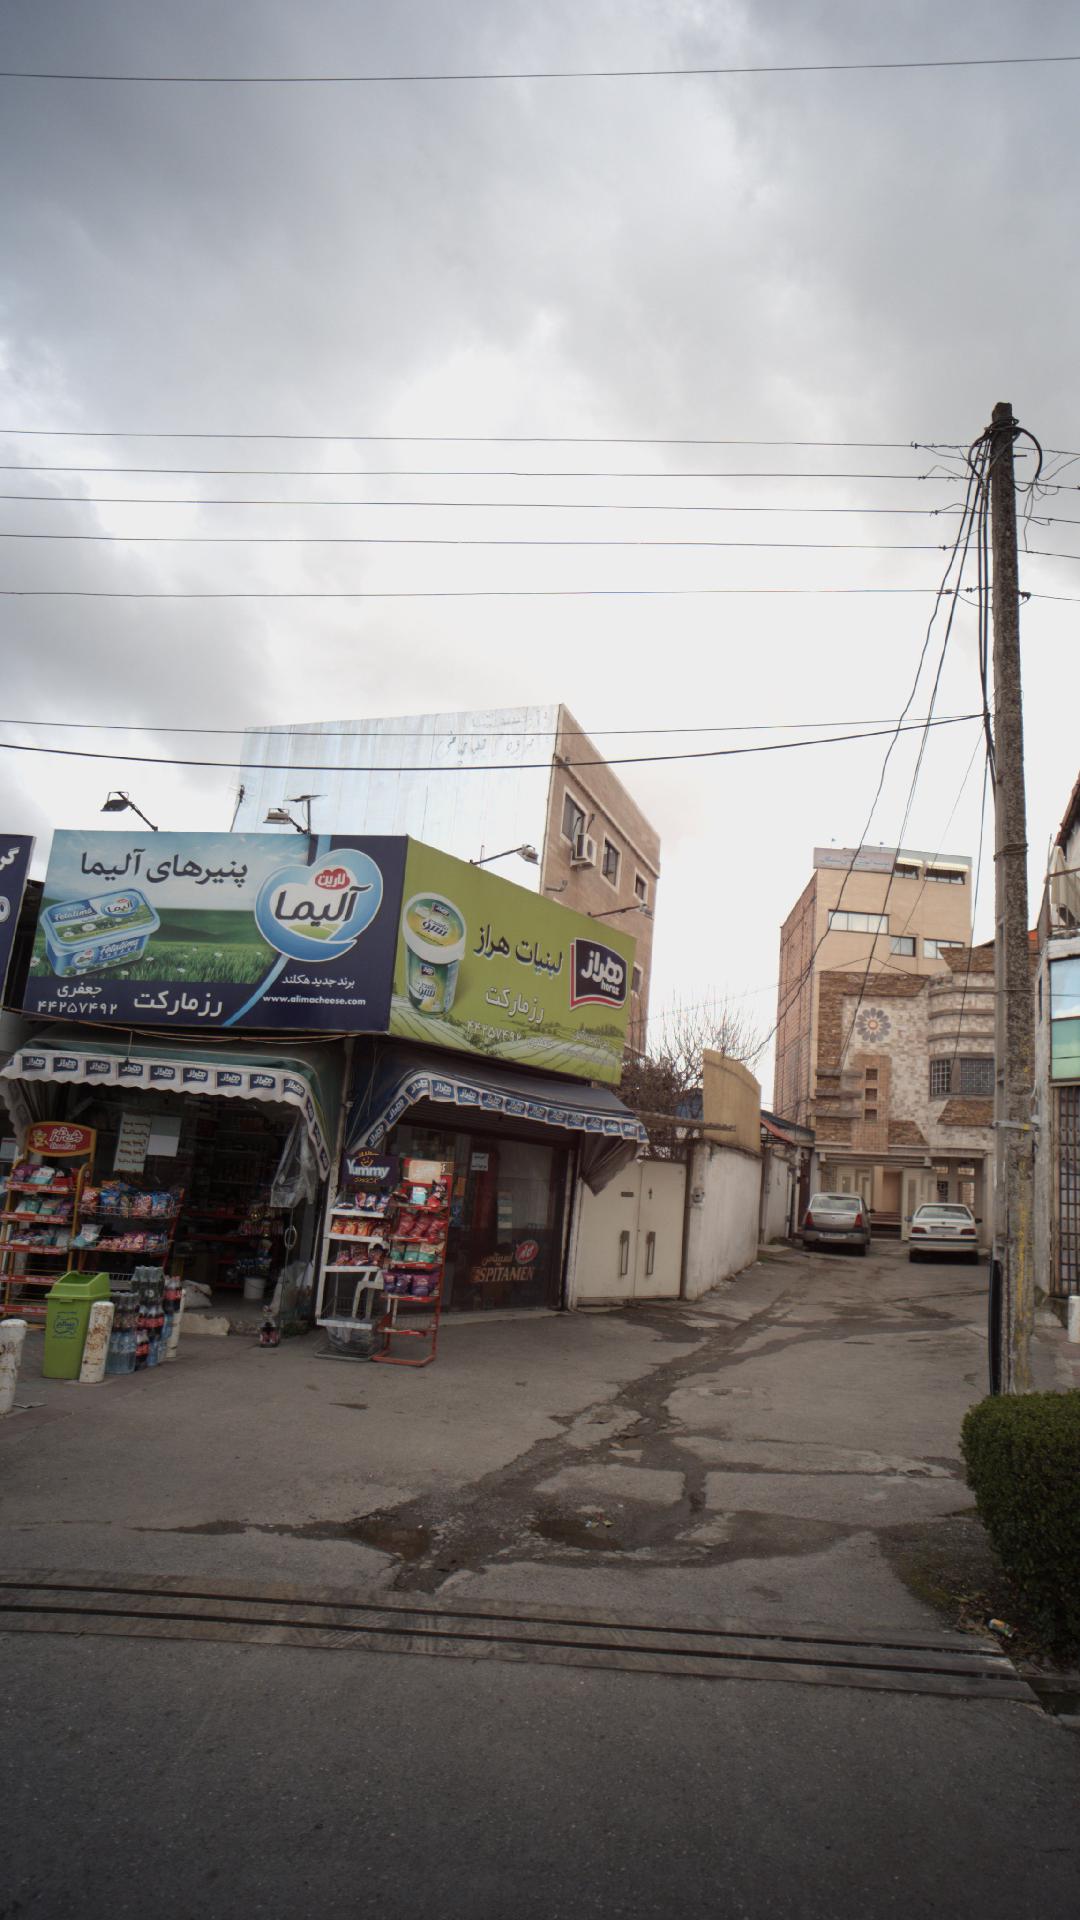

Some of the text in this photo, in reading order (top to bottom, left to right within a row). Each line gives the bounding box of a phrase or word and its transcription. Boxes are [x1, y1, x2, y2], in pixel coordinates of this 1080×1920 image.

[81, 848, 248, 888] پنیرهای آلیما
[318, 873, 345, 887] لارین
[275, 885, 371, 927] آلیما
[473, 924, 511, 960] هراز
[515, 941, 563, 978] لبنیات
[581, 950, 624, 985] هراز
[57, 982, 103, 998] جعفری
[311, 977, 337, 988] جدید
[337, 977, 355, 990] برند
[37, 1000, 118, 1016] ۴۴۲۵۷۴۹۲
[263, 995, 366, 1006] www.alimacheese.com
[346, 1159, 390, 1179] Yummy
